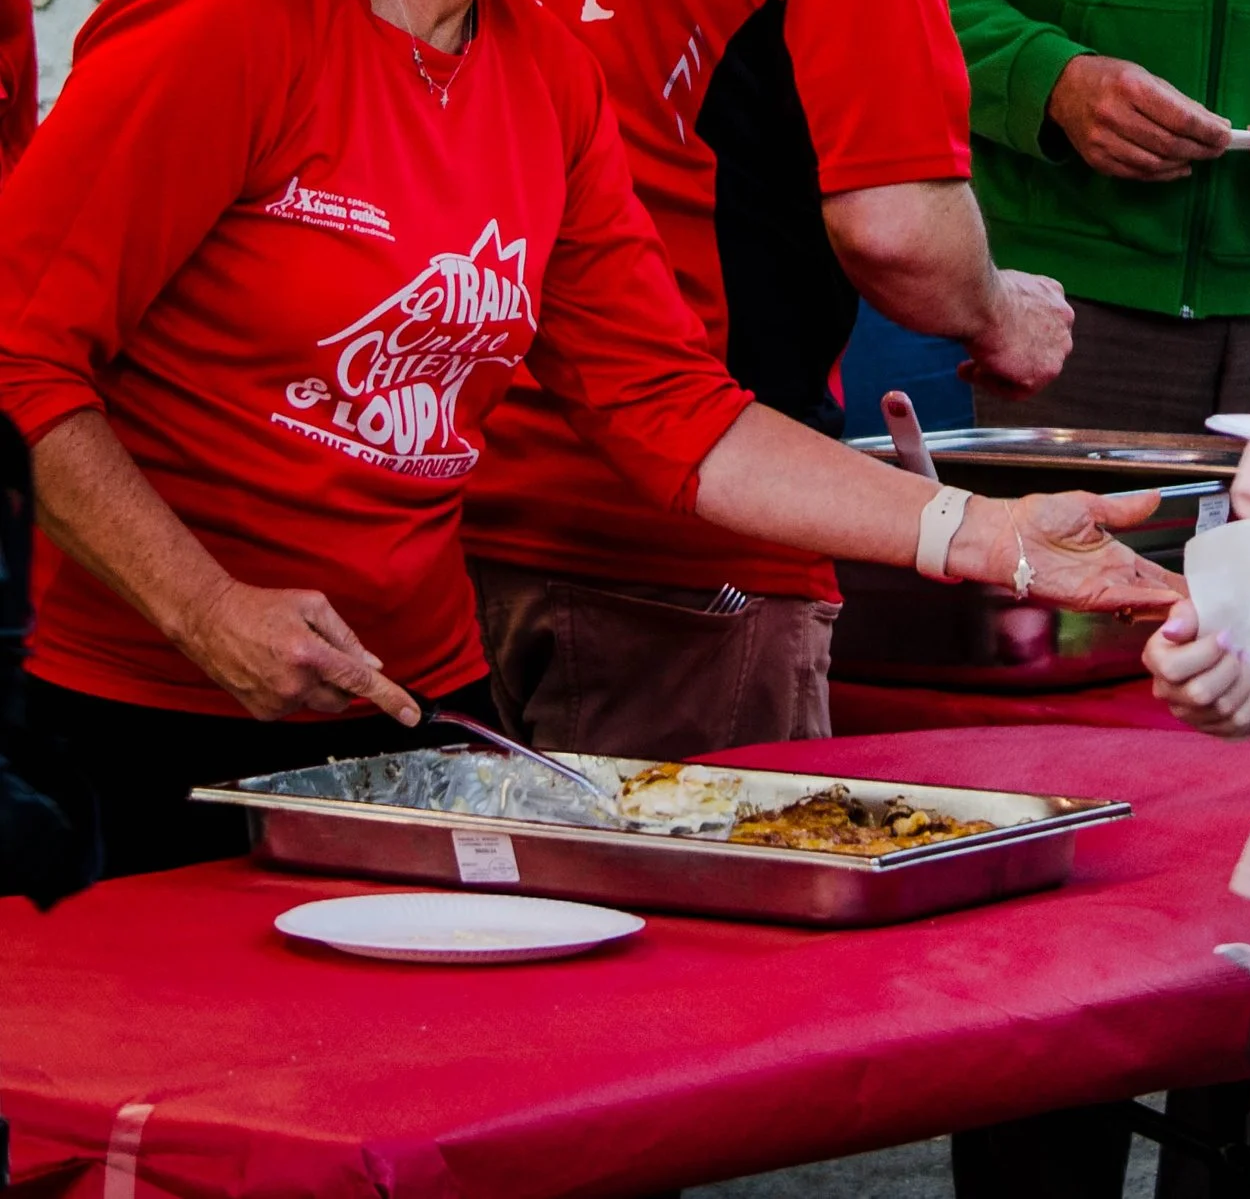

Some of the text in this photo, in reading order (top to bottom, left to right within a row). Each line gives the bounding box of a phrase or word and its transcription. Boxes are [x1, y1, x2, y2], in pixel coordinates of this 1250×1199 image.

[273, 207, 294, 219] Trail
[302, 214, 345, 230] Running
[318, 190, 344, 203] Votre
[440, 259, 522, 324] TRAIL
[337, 330, 476, 397] CHIEN
[286, 378, 331, 409] &
[332, 383, 438, 455] LOUP
[402, 455, 473, 478] DROUETTE
